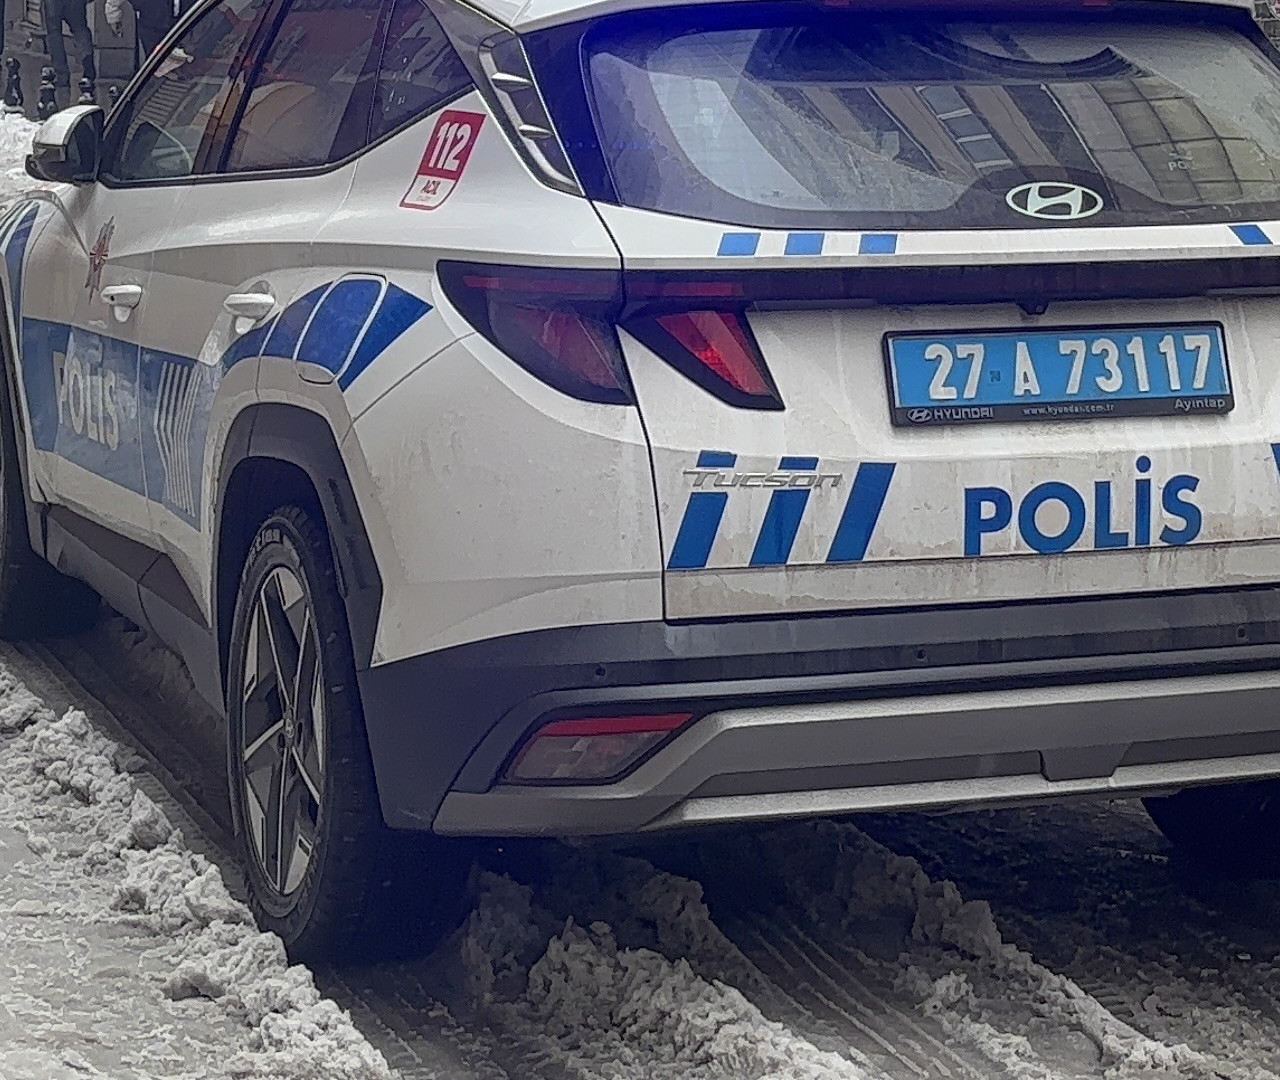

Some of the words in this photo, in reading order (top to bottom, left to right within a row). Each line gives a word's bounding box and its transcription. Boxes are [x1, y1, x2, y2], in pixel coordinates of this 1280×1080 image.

[428, 121, 471, 172] 112
[924, 344, 984, 400] 27
[1014, 341, 1041, 397] A
[1059, 334, 1211, 395] 73117
[934, 408, 993, 420] HYUNDAI
[964, 455, 1203, 557] POLİS
